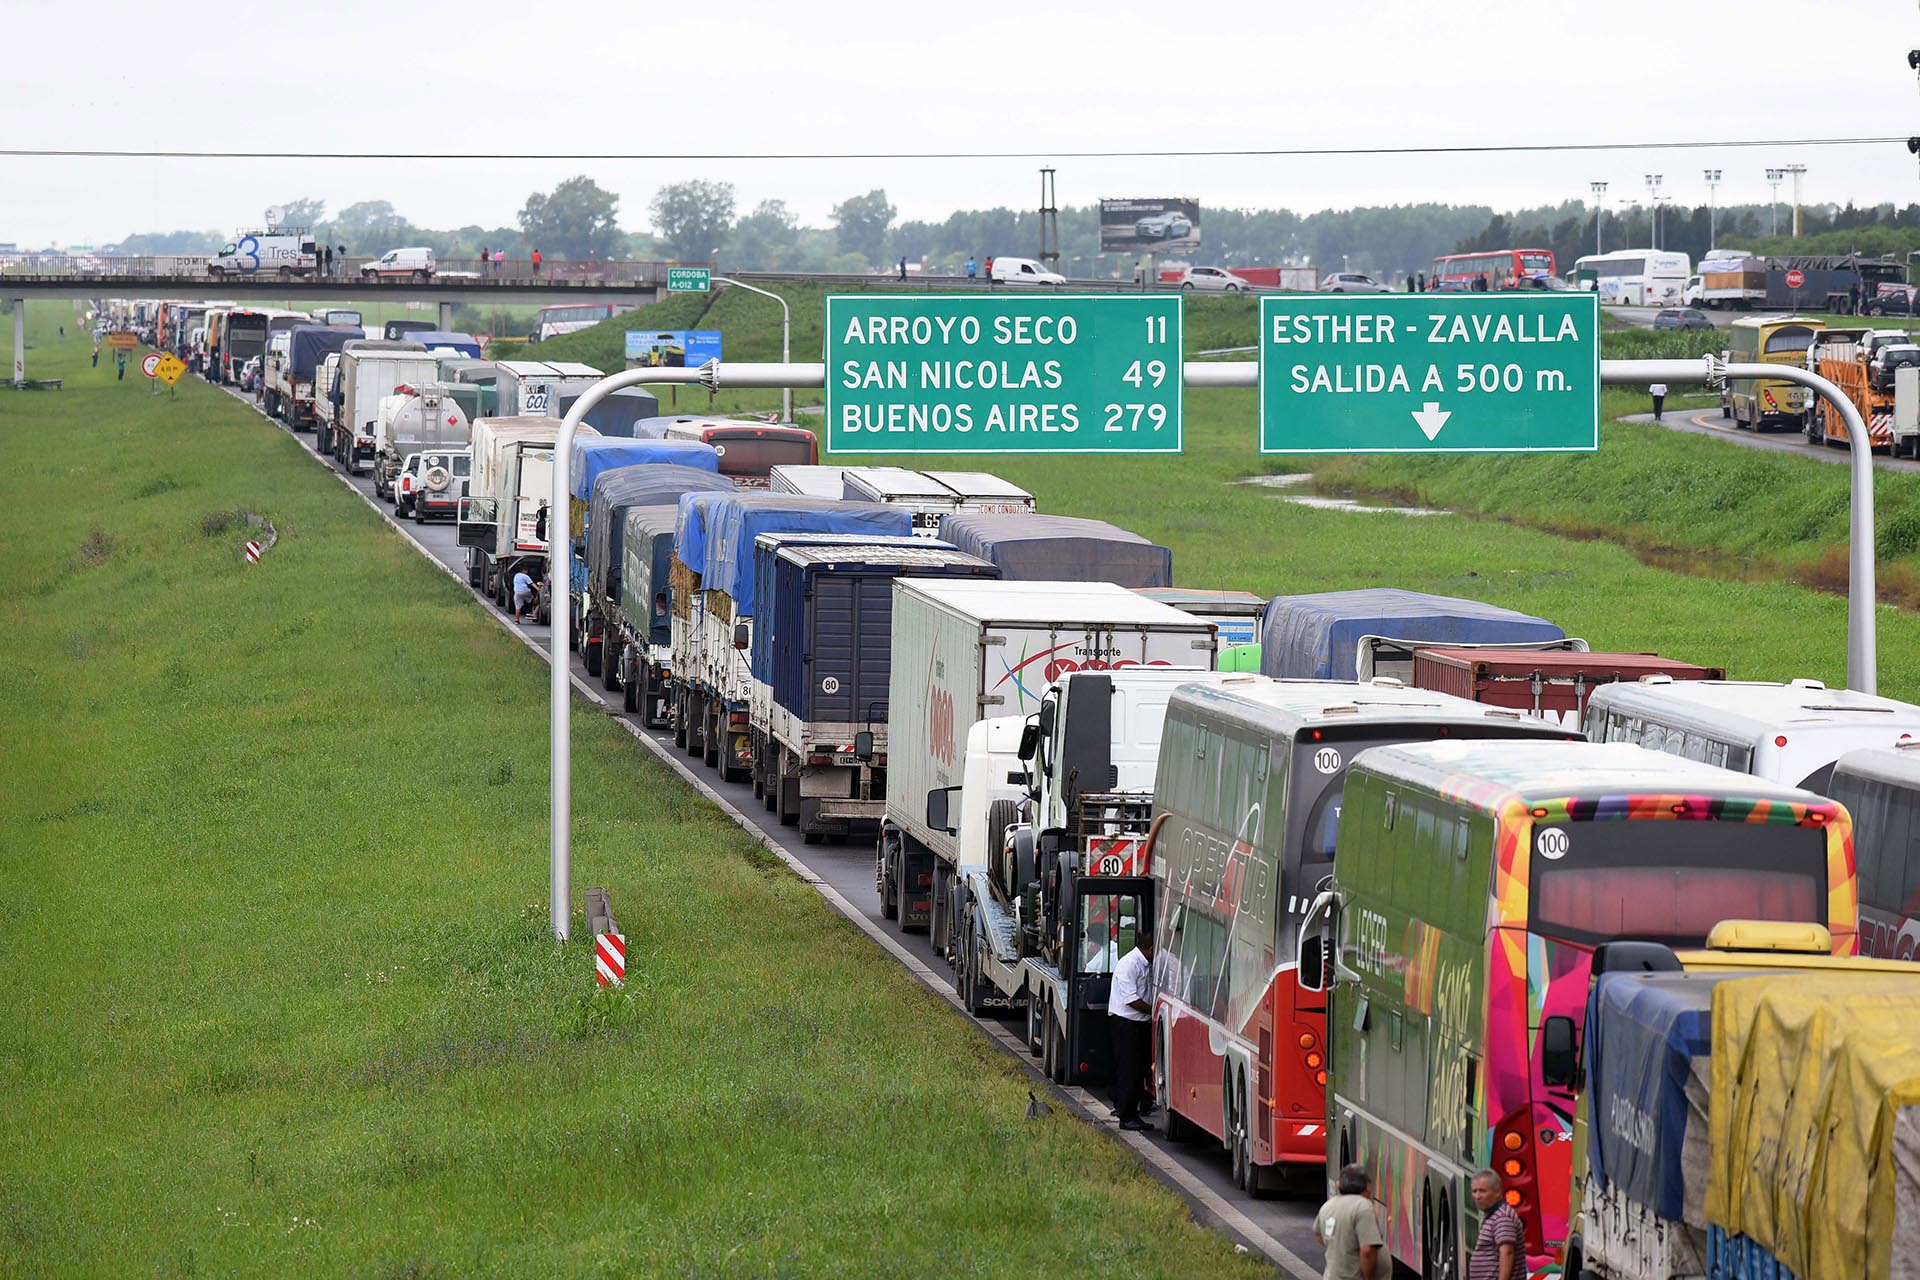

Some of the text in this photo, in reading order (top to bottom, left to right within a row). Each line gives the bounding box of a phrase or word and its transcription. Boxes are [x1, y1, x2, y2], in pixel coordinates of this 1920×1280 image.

[236, 236, 260, 274] 3
[844, 316, 1166, 345] ARROYO SECO 11
[1273, 315, 1395, 344] ESTHER
[1427, 314, 1579, 343] ZAVALLA
[843, 360, 1166, 389] SAN NICOLAS 49
[1291, 363, 1572, 393] SALIDA A 500 m.
[843, 403, 1167, 433] BUENOS AIRES 279
[1075, 646, 1121, 657] Transporte
[824, 680, 837, 691] 80
[1316, 752, 1340, 770] 100
[1540, 833, 1568, 854] 100
[1103, 858, 1119, 875] 80
[1177, 827, 1270, 924] OPERTUR
